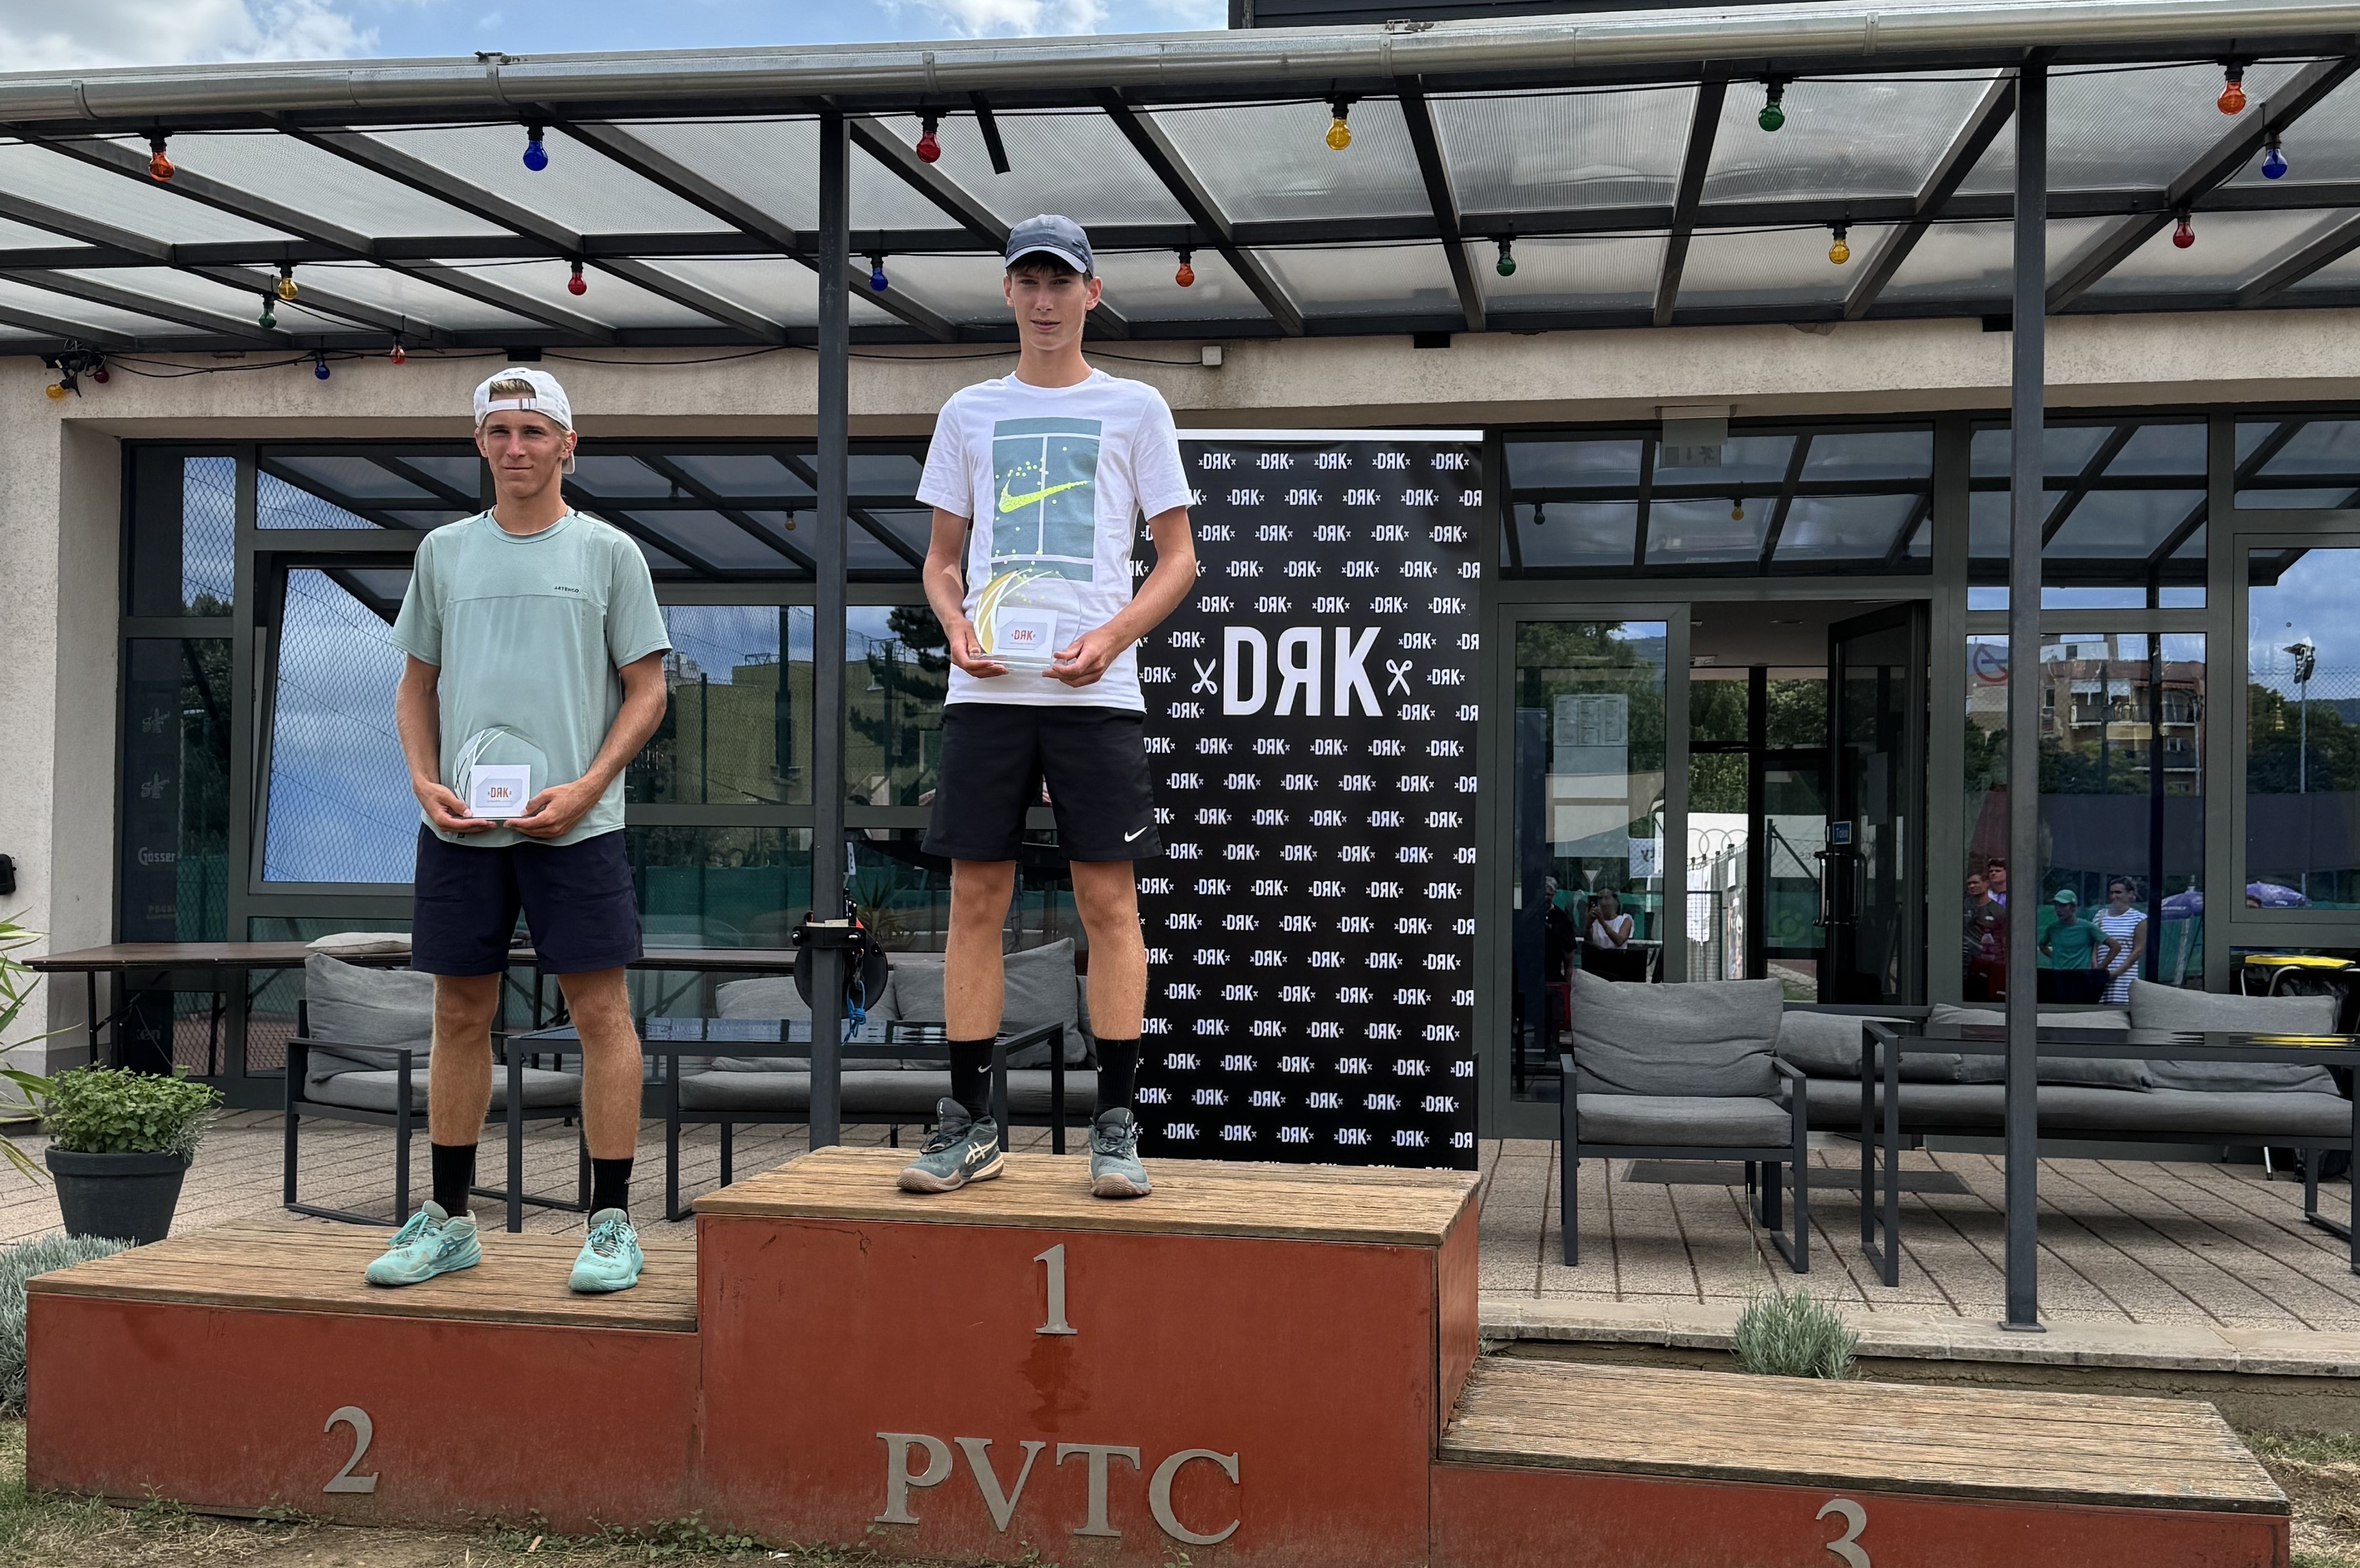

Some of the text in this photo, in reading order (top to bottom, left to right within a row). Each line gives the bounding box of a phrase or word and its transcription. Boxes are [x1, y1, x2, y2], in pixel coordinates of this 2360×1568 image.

[1033, 1243, 1078, 1334] 1
[322, 1406, 379, 1493] 2
[874, 1432, 1241, 1545] PVTC
[1815, 1498, 1871, 1568] 3
